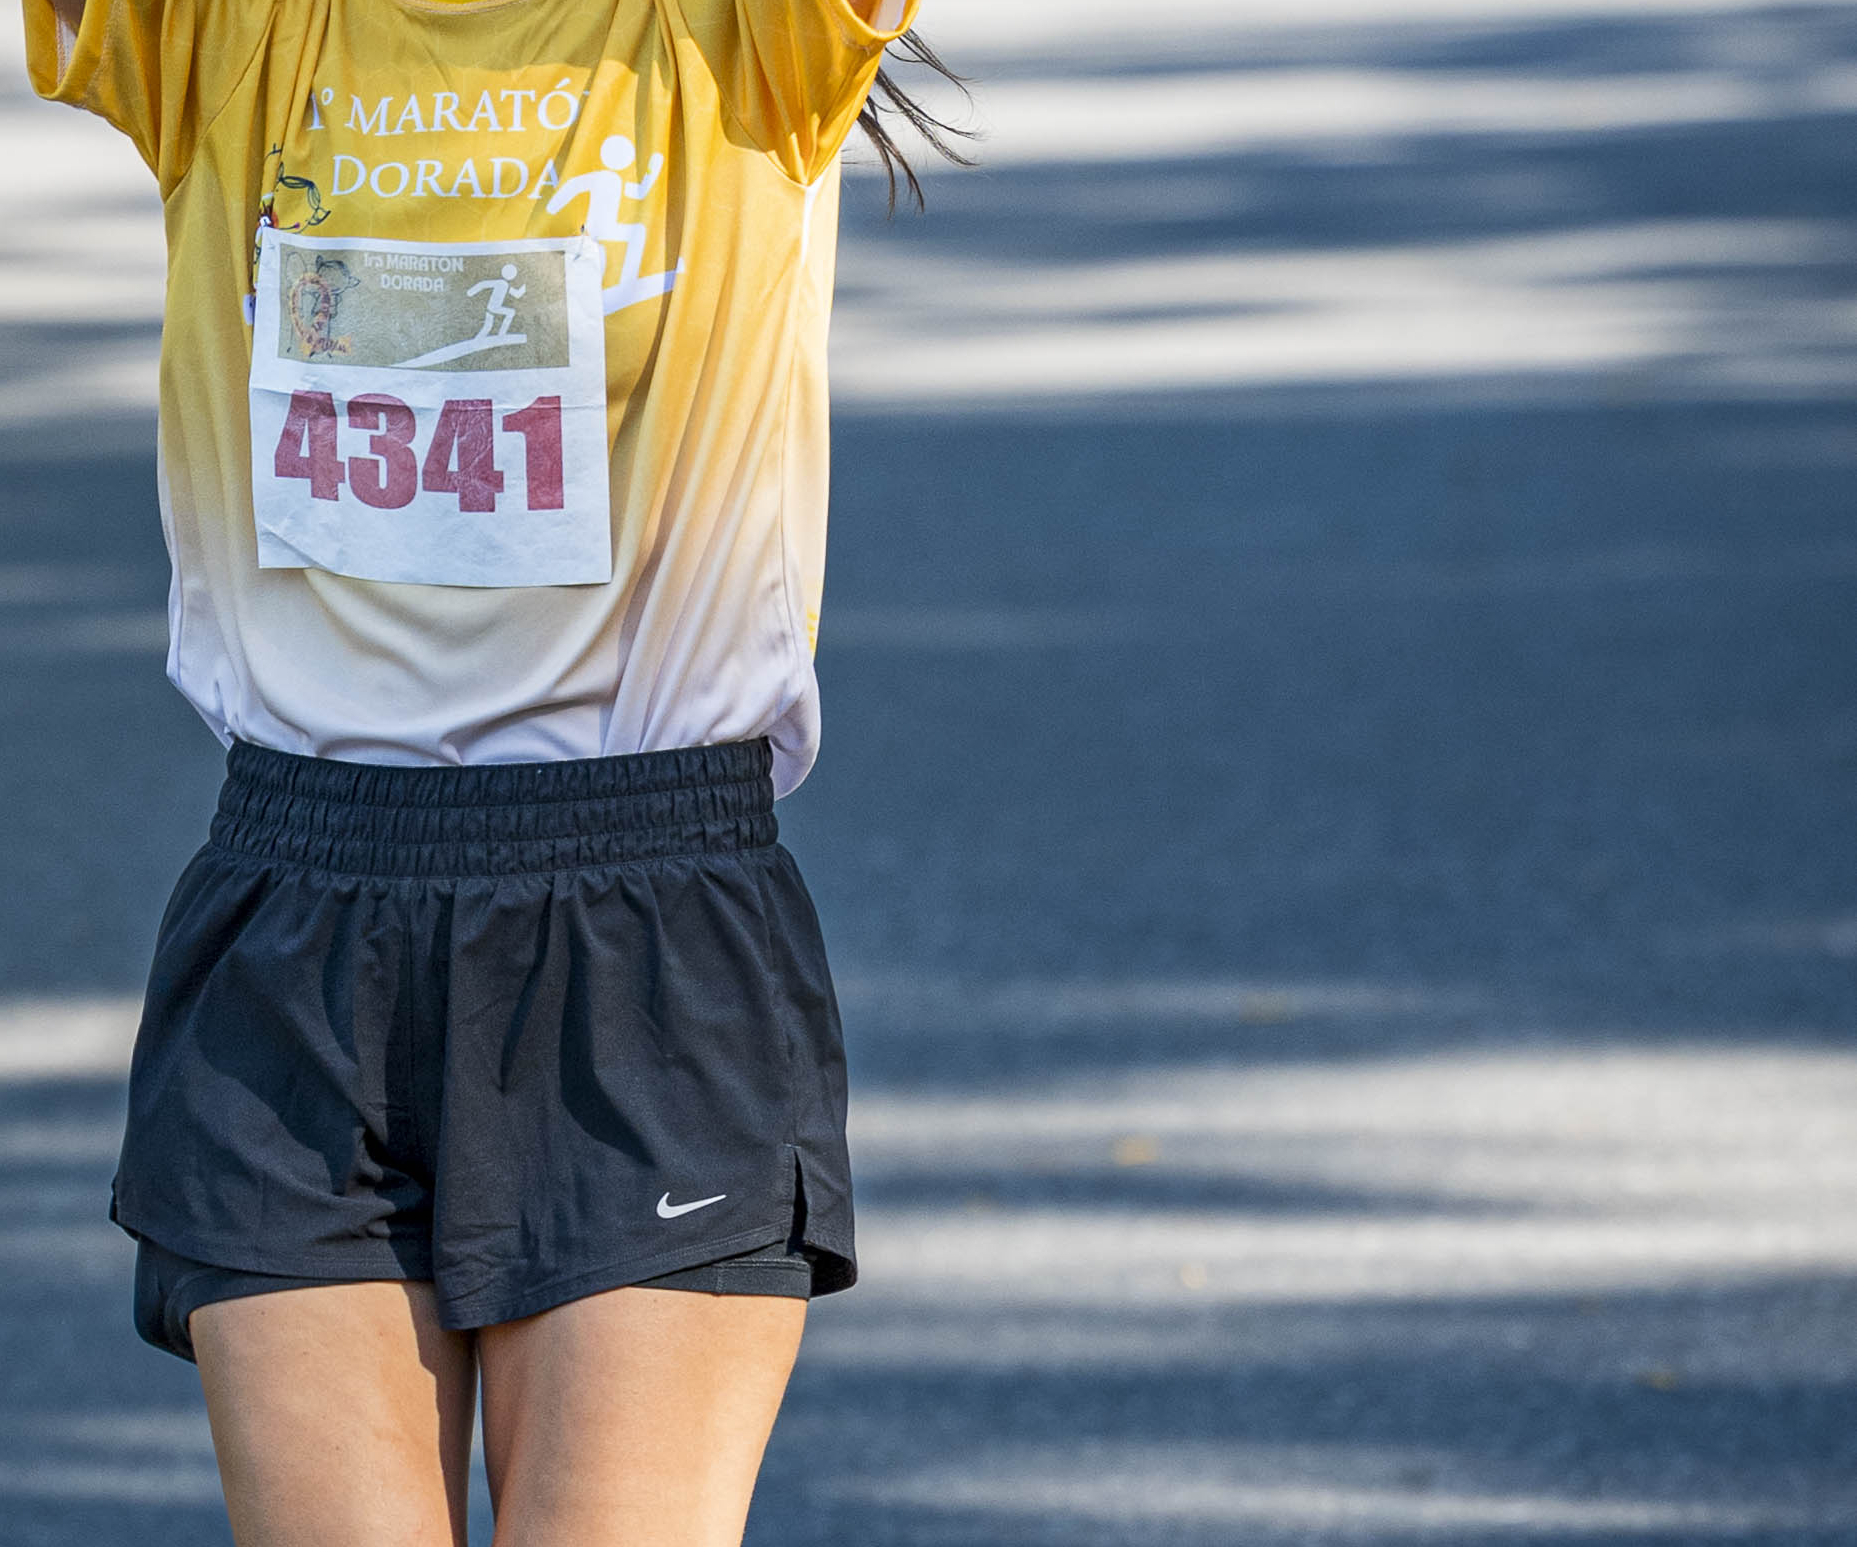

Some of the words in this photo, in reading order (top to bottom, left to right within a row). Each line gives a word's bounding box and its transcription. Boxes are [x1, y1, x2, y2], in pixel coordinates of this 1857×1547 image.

[344, 77, 591, 137] MARATÓ
[330, 154, 561, 199] DORADA
[380, 274, 445, 293] DORADA
[274, 389, 565, 513] 4341
